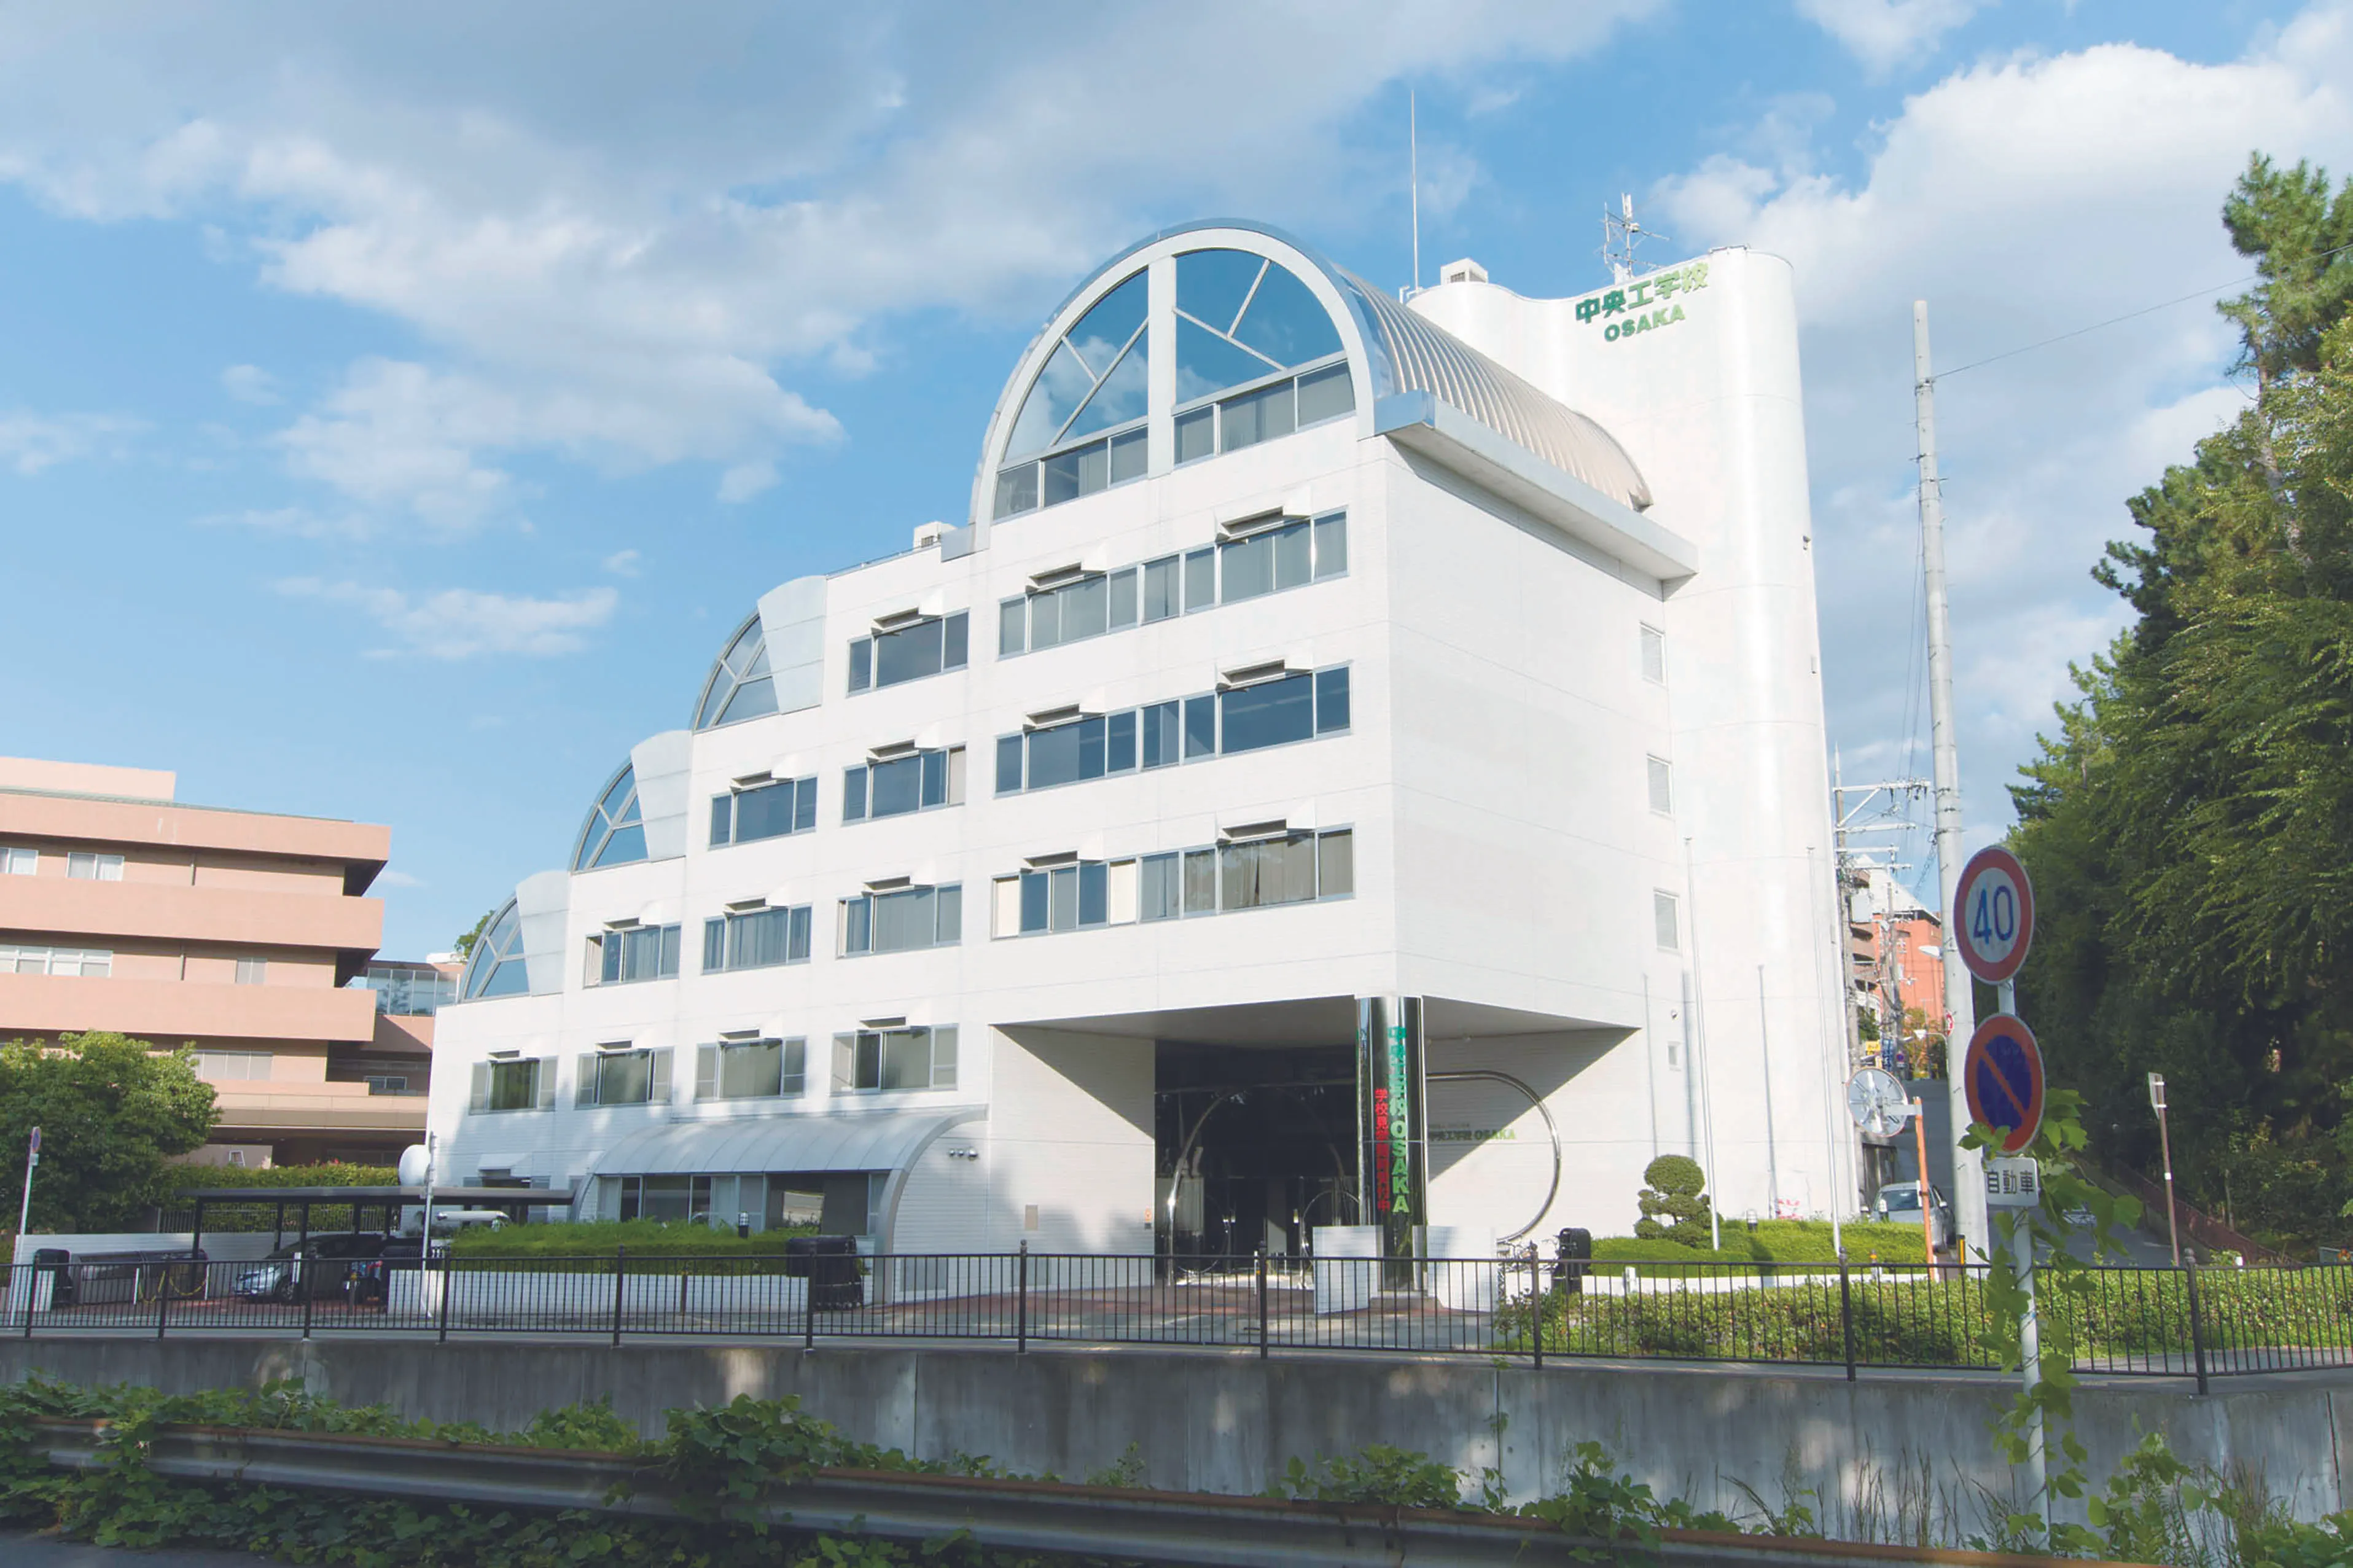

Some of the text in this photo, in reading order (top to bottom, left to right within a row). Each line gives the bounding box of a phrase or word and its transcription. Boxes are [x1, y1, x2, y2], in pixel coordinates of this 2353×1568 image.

[1575, 262, 1709, 324] 中央工学校
[1604, 304, 1685, 342] OSAKA
[1973, 886, 2013, 944] 40
[1391, 1120, 1410, 1213] OSAKA
[1987, 1168, 2034, 1195] 自動車
